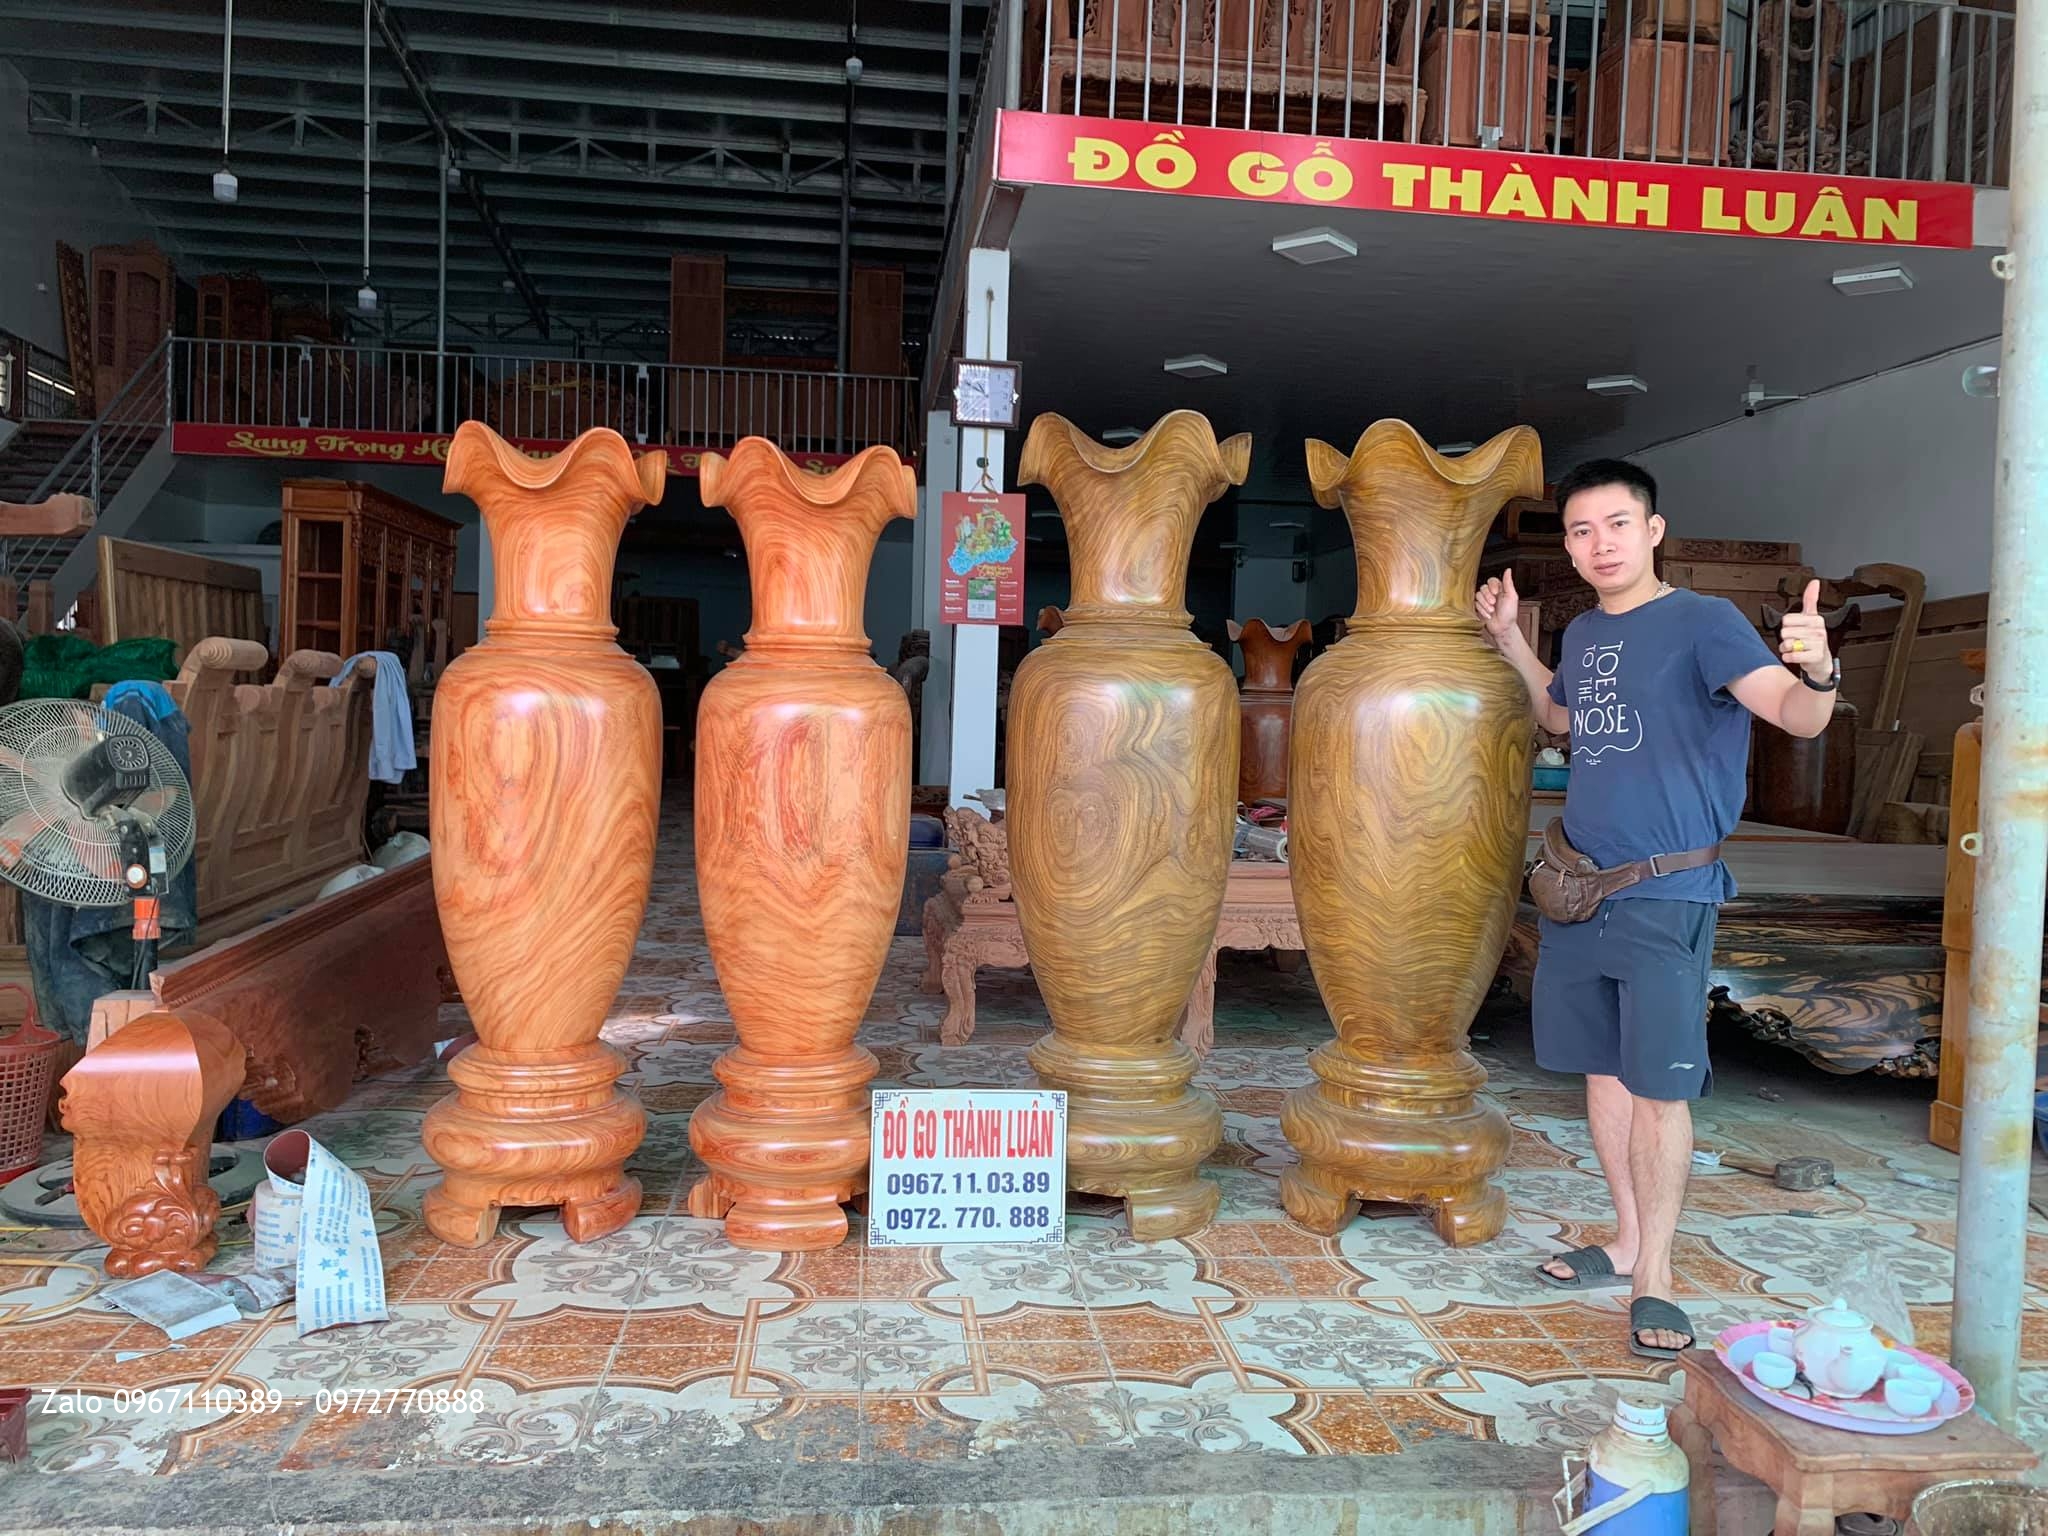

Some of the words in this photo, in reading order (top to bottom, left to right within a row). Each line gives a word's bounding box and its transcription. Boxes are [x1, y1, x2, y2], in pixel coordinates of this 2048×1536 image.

[1067, 129, 1198, 189] ĐỒ
[1227, 141, 1354, 202] GỖ
[1382, 162, 1670, 227] THÀNH
[1701, 186, 1918, 241] LUÂN
[226, 431, 307, 457] Sang
[315, 434, 405, 460] Trọng
[1578, 677, 1593, 704] THE
[1595, 640, 1624, 703] TOES
[1574, 704, 1630, 737] NOSE
[883, 1097, 909, 1159] ĐỒ
[943, 1100, 1002, 1158] THÀNH
[1007, 1100, 1054, 1158] LUÂN
